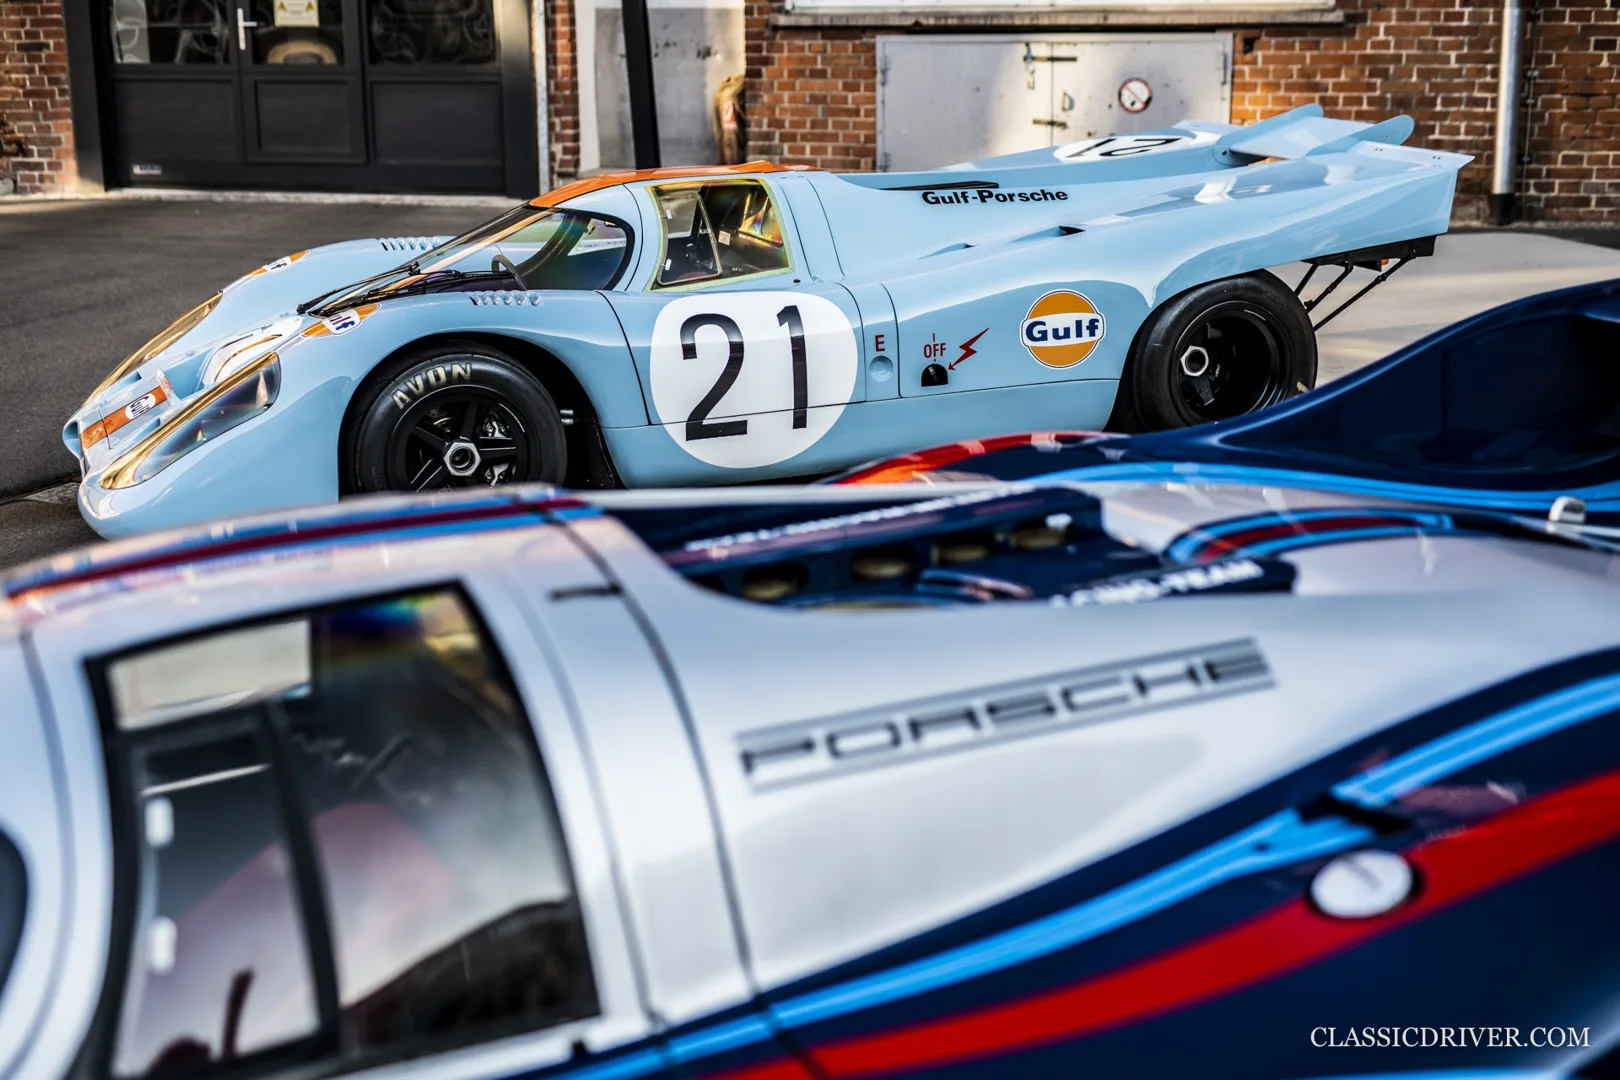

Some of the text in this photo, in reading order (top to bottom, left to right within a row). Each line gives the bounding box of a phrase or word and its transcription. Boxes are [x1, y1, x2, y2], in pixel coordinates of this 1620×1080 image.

[921, 189, 1069, 205] Gulf-Porsche
[1025, 318, 1100, 342] Gulf
[874, 334, 886, 352] E
[923, 342, 947, 359] OFF
[680, 305, 808, 441] 21
[392, 362, 472, 410] AVON
[738, 650, 1273, 780] PORSCHE
